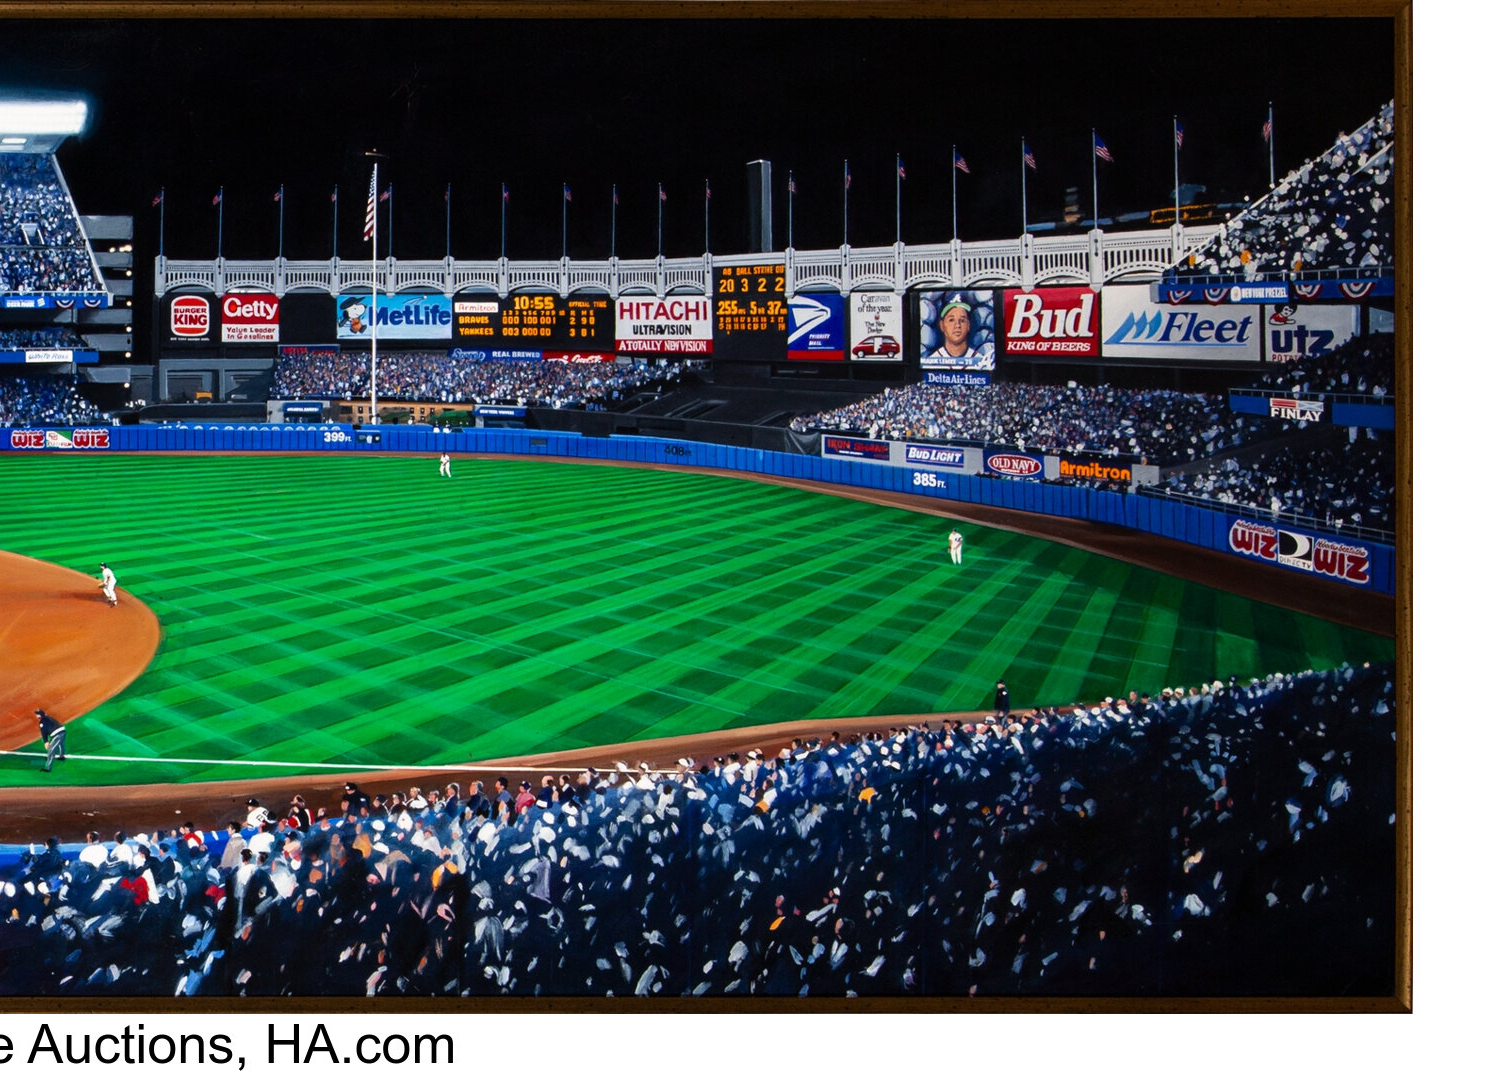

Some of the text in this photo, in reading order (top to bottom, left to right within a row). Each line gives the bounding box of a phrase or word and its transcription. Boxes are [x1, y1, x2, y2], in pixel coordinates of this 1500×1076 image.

[736, 267, 752, 275] BALL
[753, 265, 773, 274] STRIKE
[719, 277, 785, 292] 20 3 2 2
[514, 296, 555, 310] 10:55
[861, 294, 890, 303] Caravan
[223, 297, 277, 320] Getty
[369, 304, 451, 326] MetLife
[459, 304, 496, 312] Armitron
[619, 301, 708, 320] HITACHI
[716, 301, 738, 315] .255
[750, 301, 757, 315] 5
[767, 301, 781, 315] 37
[858, 305, 865, 313] of
[866, 304, 876, 313] the
[174, 313, 207, 325] KING
[458, 316, 489, 325] BRAVES
[569, 317, 576, 325] 2
[581, 317, 587, 325] 9
[1007, 293, 1094, 338] Bud
[459, 327, 494, 336] YANKEES
[569, 328, 576, 337] 3
[591, 328, 595, 337] 1
[633, 324, 692, 335] ULTRAVISION
[1158, 312, 1252, 343] Fleet
[619, 341, 707, 352] A TOTALLY NEW VISION
[1007, 341, 1091, 352] KING OF BEERS
[1271, 325, 1334, 354] utz
[927, 372, 987, 385] Delta Air Lines
[1271, 407, 1321, 422] FINLAY
[12, 434, 44, 447] WIZ
[73, 434, 109, 447] WIZ
[324, 432, 345, 443] 399
[664, 445, 684, 456] 408
[908, 447, 963, 462] BUD LIGHT
[992, 457, 1011, 469] OLD
[1011, 459, 1035, 471] NAVY
[1060, 460, 1131, 480] Armitron
[913, 472, 936, 488] 385
[1232, 527, 1277, 559] WIZ
[1313, 547, 1368, 581] WIZ
